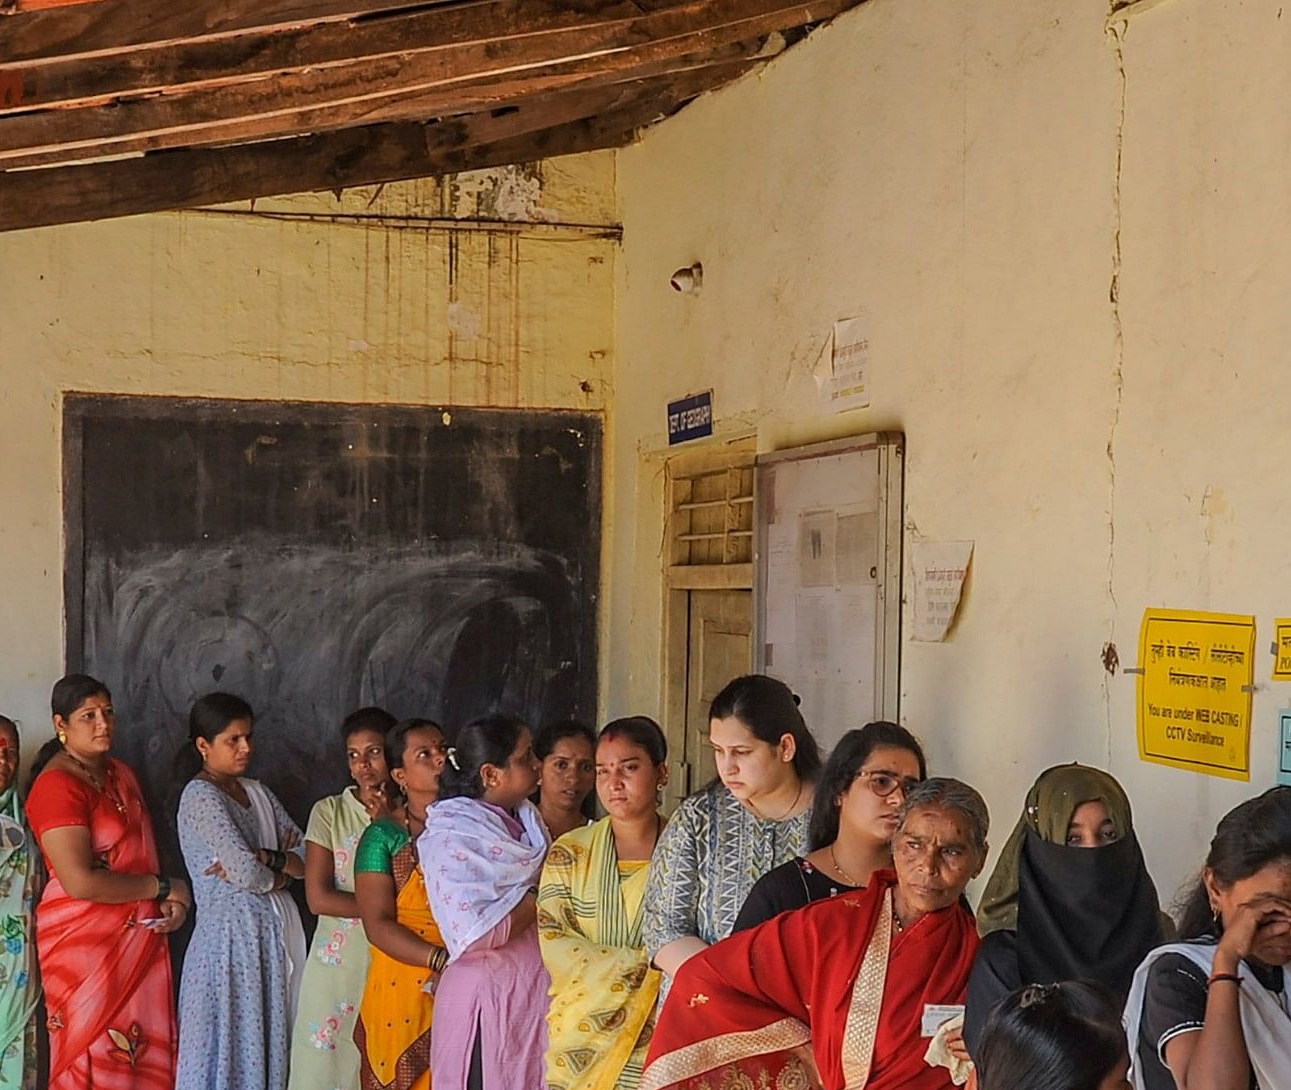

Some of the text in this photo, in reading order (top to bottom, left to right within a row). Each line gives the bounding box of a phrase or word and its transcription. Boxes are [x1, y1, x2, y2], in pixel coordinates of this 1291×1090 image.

[1148, 703, 1160, 718] You
[1162, 707, 1172, 718] are
[1174, 707, 1194, 720] under
[1195, 708, 1209, 723] WEB
[1211, 711, 1238, 727] CASTING
[1166, 725, 1224, 747] CCTV Surveillance
